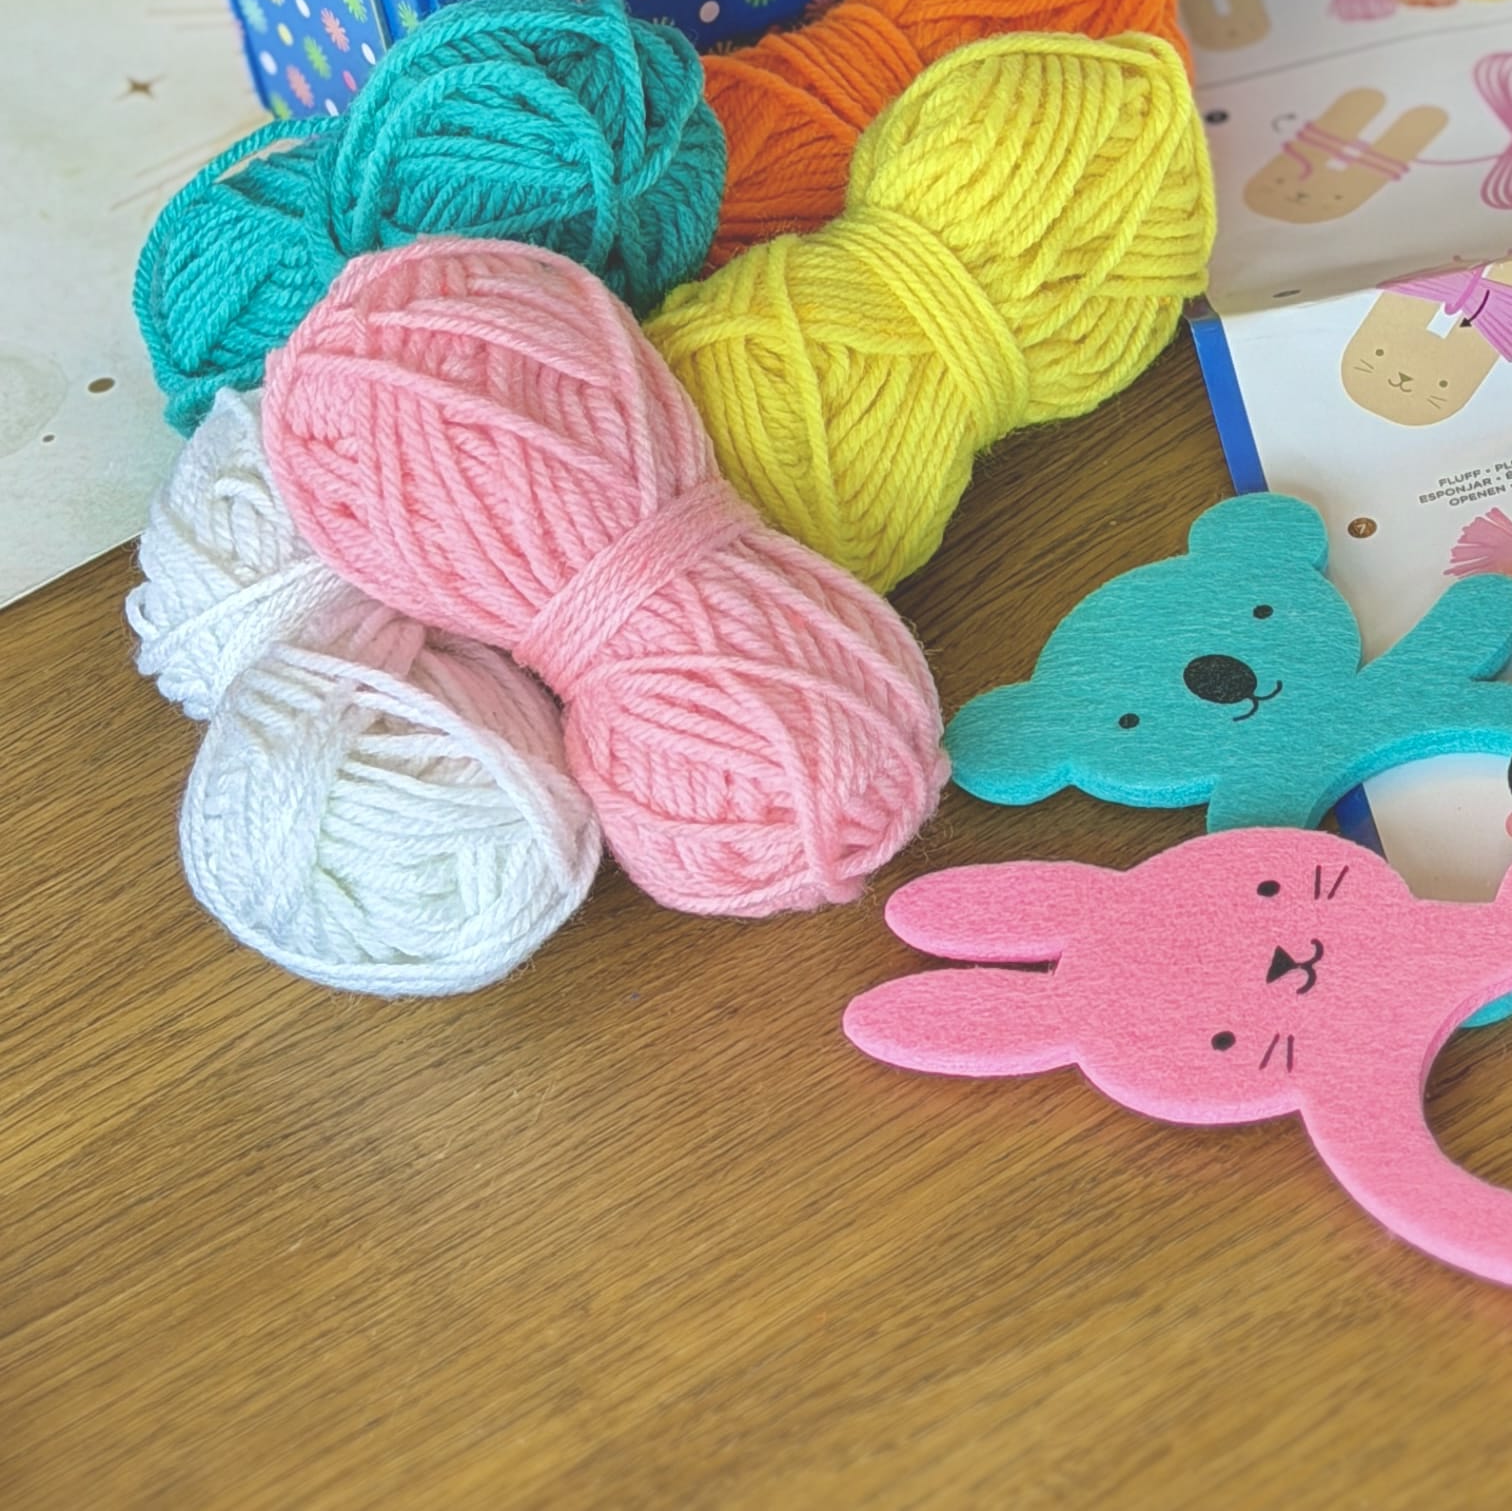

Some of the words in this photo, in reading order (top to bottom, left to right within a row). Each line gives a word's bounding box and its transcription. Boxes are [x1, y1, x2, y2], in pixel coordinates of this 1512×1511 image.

[1438, 469, 1481, 487] FLUFF
[1418, 477, 1493, 505] ESPONJAR
[1448, 484, 1507, 507] OPENEN
